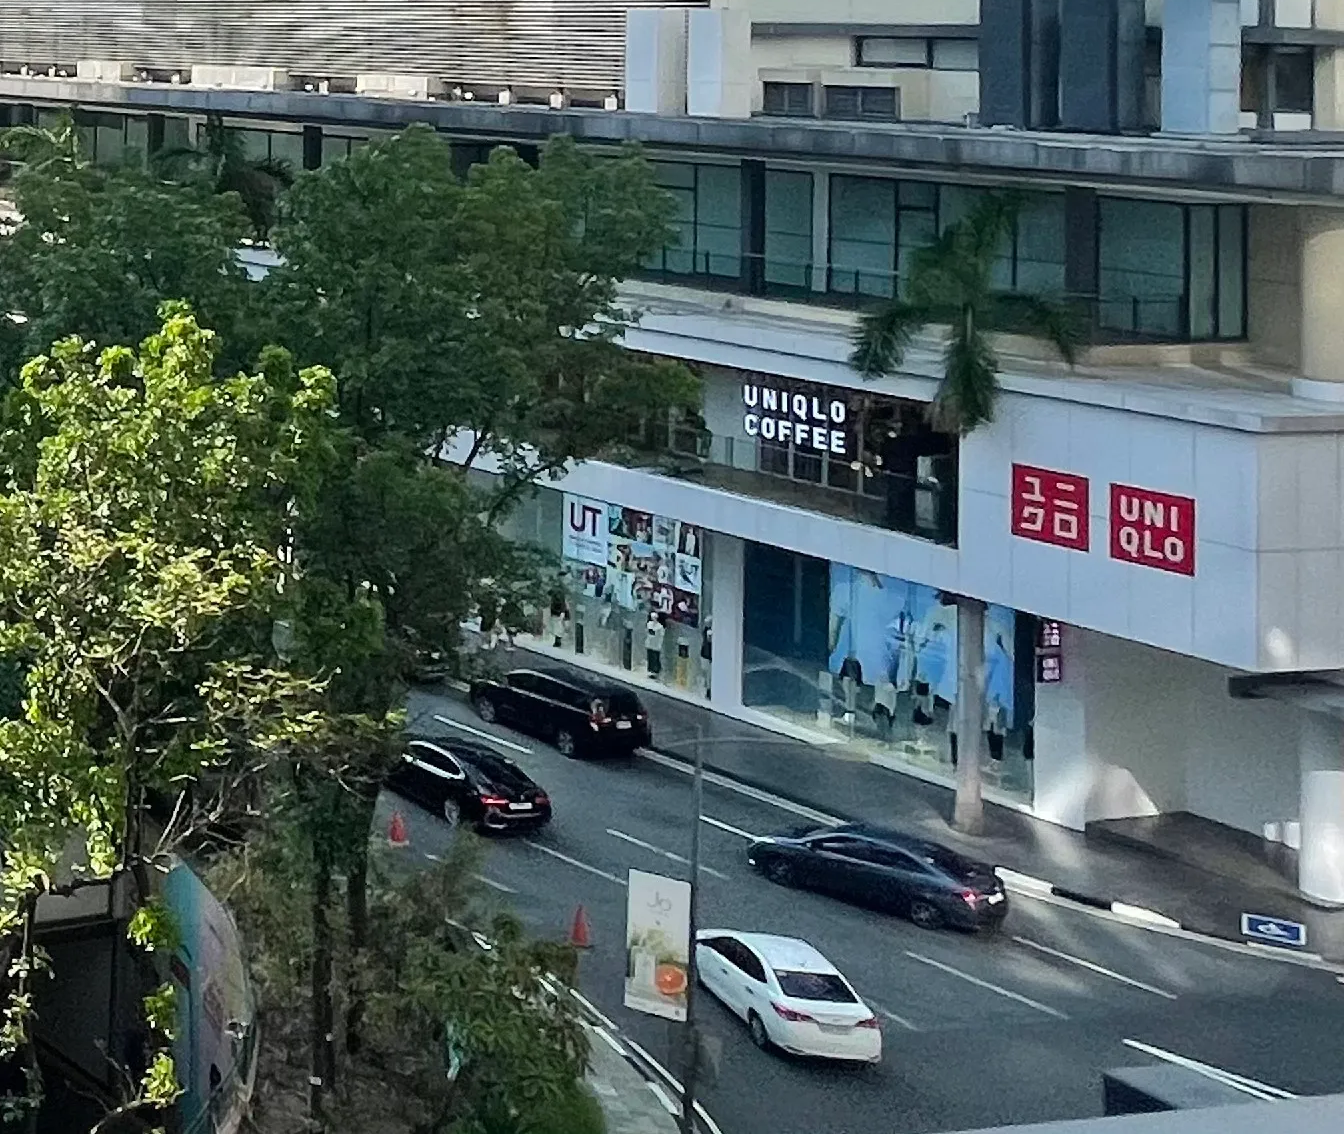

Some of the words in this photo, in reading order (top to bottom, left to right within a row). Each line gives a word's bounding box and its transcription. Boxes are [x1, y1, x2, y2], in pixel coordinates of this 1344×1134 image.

[743, 384, 847, 424] UNIQLO
[743, 413, 847, 454] COFFEE
[570, 502, 602, 537] UT
[1119, 494, 1180, 532] UNI
[1118, 526, 1185, 564] QLO
